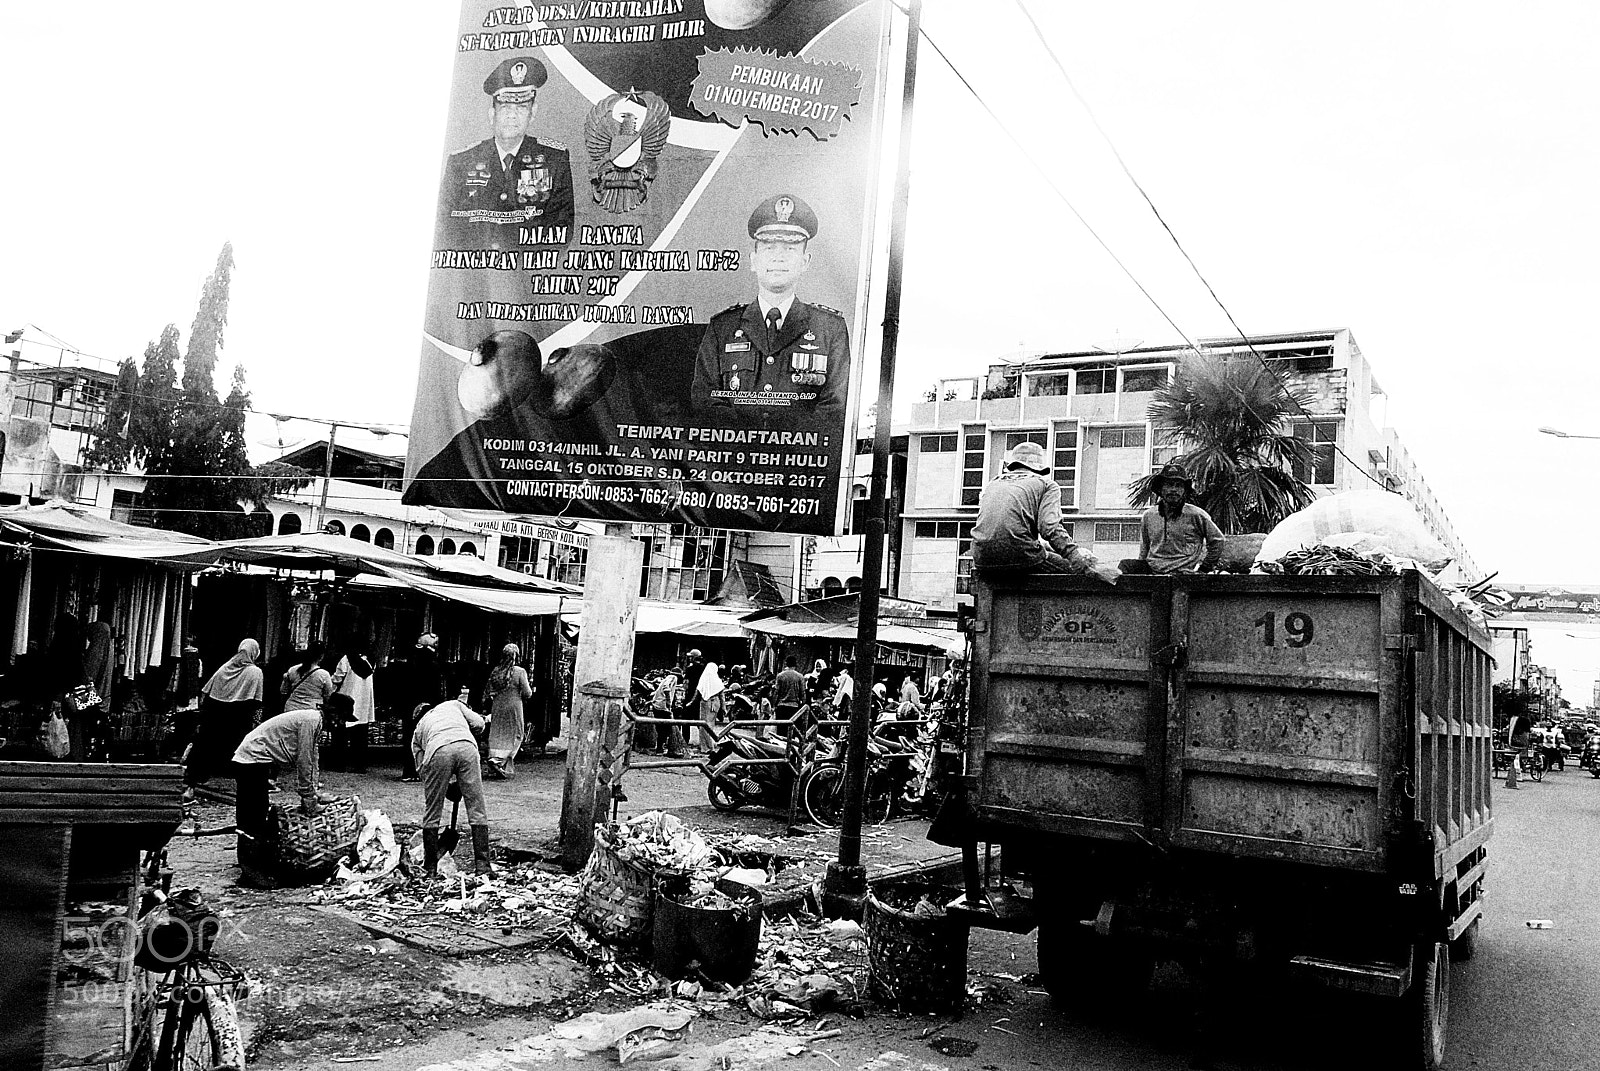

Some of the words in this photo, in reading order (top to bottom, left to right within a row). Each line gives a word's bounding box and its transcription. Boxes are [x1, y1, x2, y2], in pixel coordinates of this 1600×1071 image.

[483, 6, 533, 27] ANTAR
[458, 27, 567, 52] SE-KABUPATEN
[572, 24, 656, 45] INDRAGIRI
[661, 20, 706, 40] HILIR
[730, 64, 823, 95] PEMBUKAAN
[720, 86, 801, 116] NOVEMBER
[800, 100, 839, 123] 2017
[518, 225, 568, 245] DALAM
[580, 225, 644, 245] RANGKA
[431, 249, 518, 270] PERINGATAN
[522, 250, 559, 270] HARI
[563, 250, 614, 271] JUANG
[620, 250, 690, 271] KARTIKA
[696, 250, 740, 271] KE-72
[532, 275, 583, 294] TAHUN
[587, 276, 620, 296] 2017
[457, 302, 483, 320] DAN
[486, 302, 579, 321] MELESTARIKAN
[583, 304, 636, 323] BUDAYA
[642, 305, 694, 324] BANGSA
[616, 424, 684, 440] TEMPAT
[688, 427, 818, 446] PENDAFTARAN
[483, 438, 525, 451] KODIM
[528, 441, 601, 456] 0314/INHIL
[605, 445, 626, 457] JL.
[630, 446, 645, 459] A.
[650, 448, 683, 461] YANI
[687, 450, 732, 463] PARIT
[736, 452, 745, 464] 9
[750, 452, 780, 466] TBH
[785, 454, 828, 468] HULU
[499, 457, 562, 473] TANGGAL
[566, 461, 583, 474] 15
[587, 463, 654, 478] OKTOBER
[657, 467, 686, 480] S.D.
[689, 468, 707, 481] 24
[711, 470, 784, 486] OKTOBER
[788, 474, 827, 488] 2017
[502, 521, 518, 533] KOTA
[1255, 611, 1314, 648] 19
